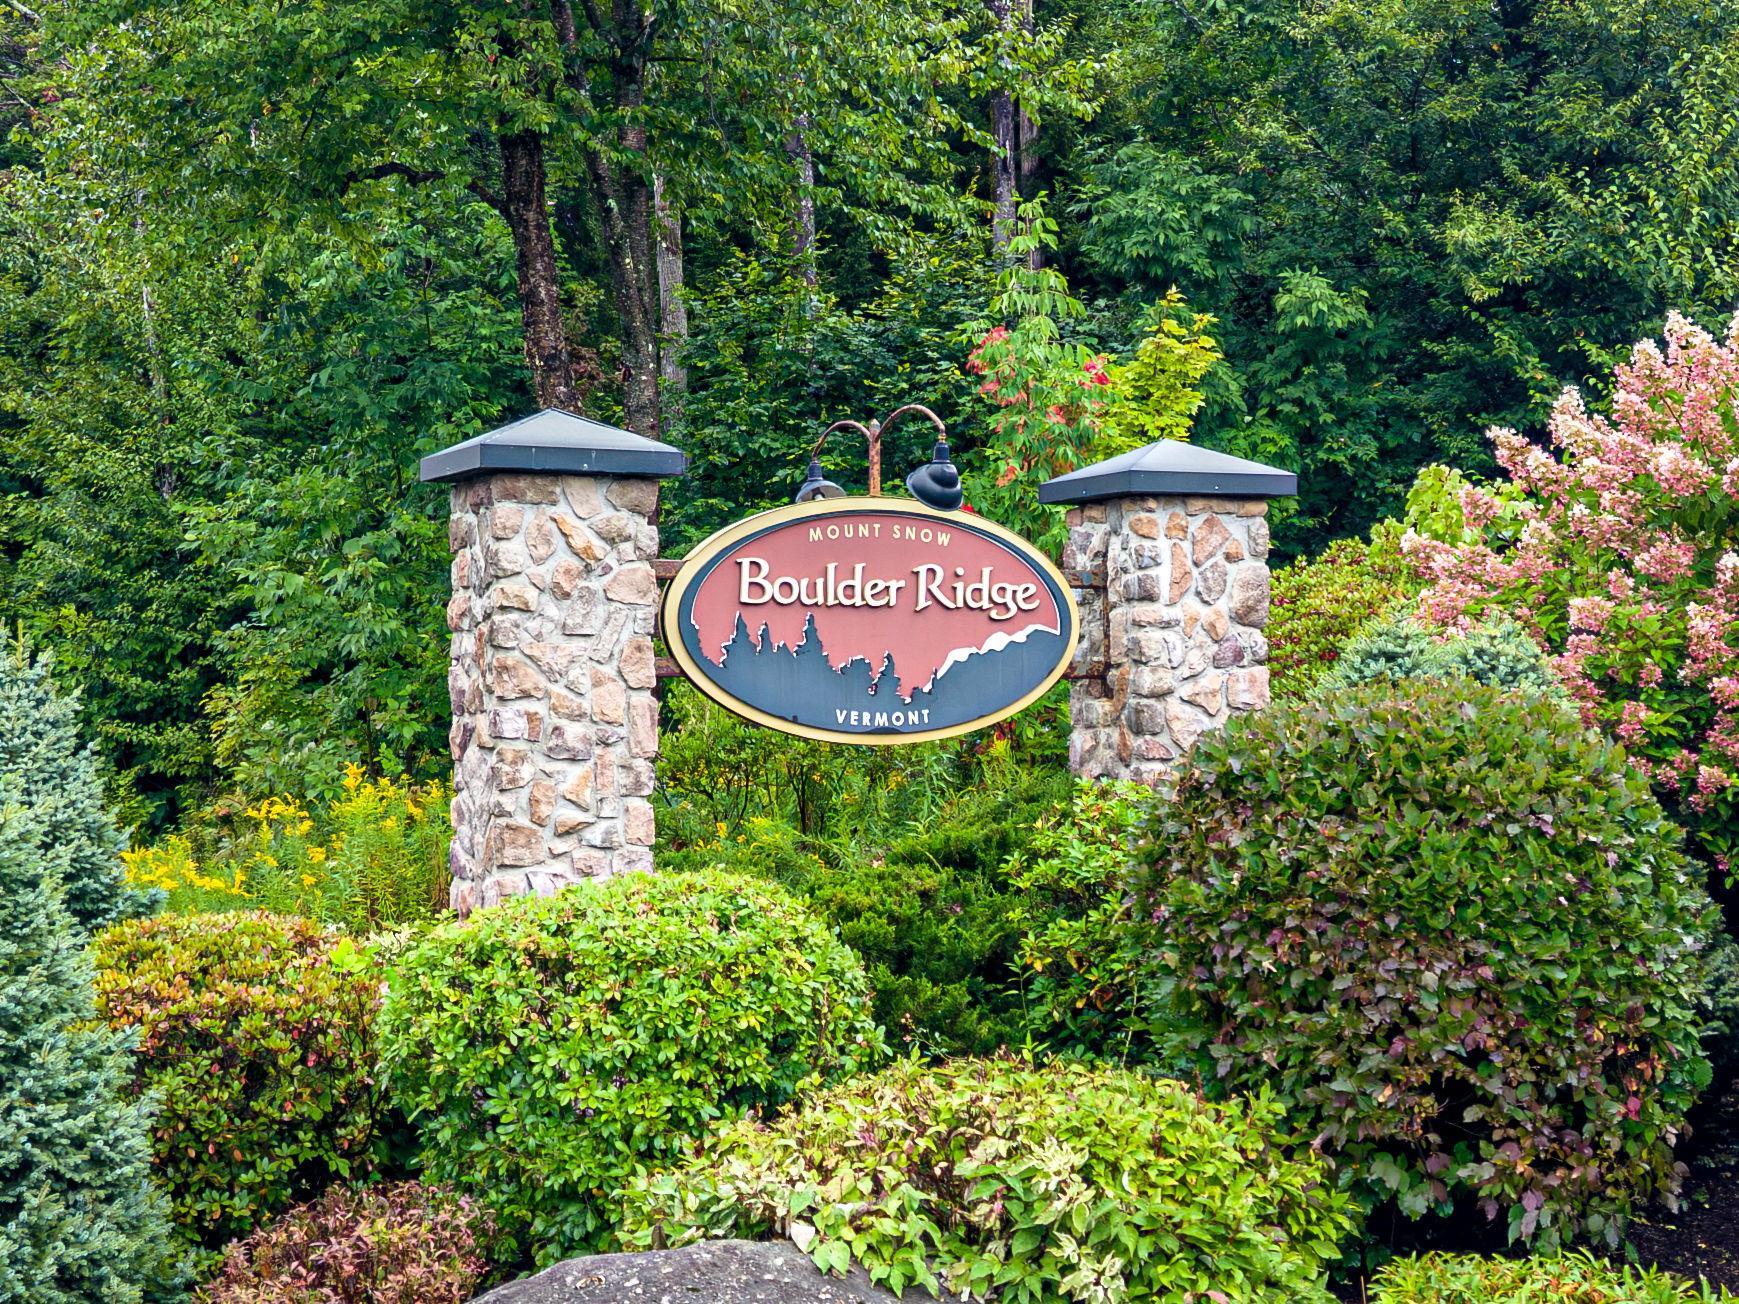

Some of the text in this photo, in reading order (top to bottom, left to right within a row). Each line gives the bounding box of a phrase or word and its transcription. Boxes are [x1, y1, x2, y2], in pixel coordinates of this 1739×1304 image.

[808, 523, 951, 547] MOUNT SNOW
[736, 557, 1040, 620] Boulder Ridge
[835, 708, 930, 727] VERMONT
